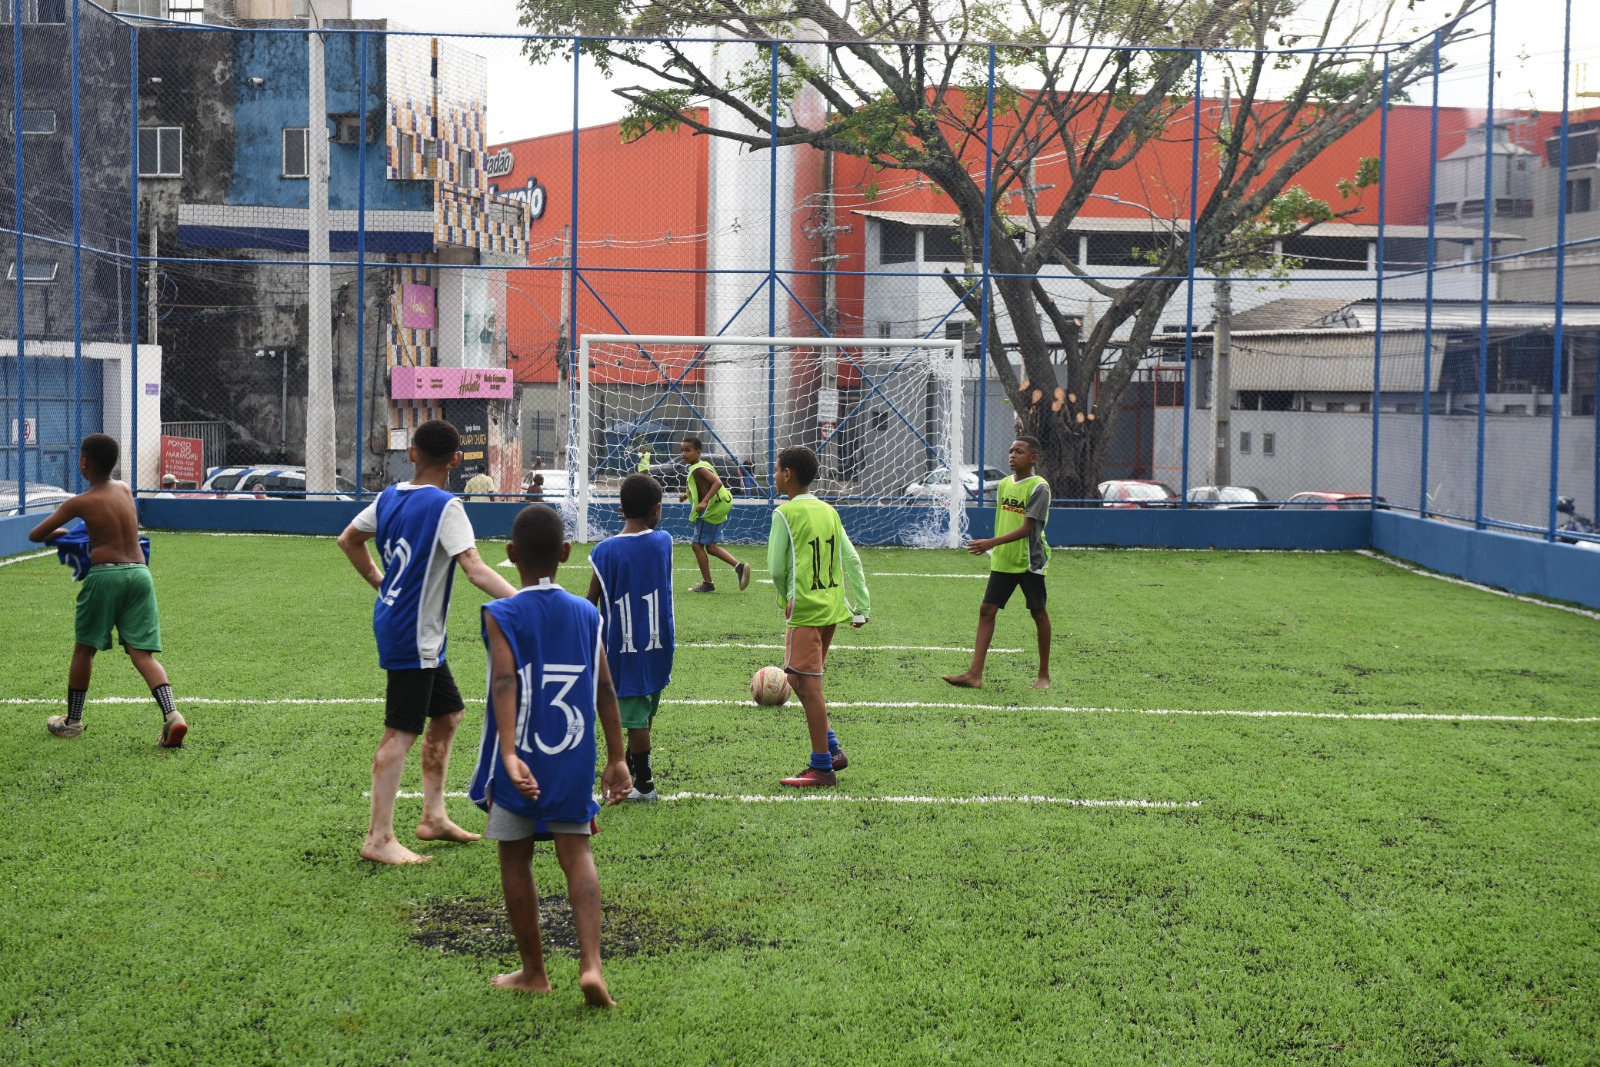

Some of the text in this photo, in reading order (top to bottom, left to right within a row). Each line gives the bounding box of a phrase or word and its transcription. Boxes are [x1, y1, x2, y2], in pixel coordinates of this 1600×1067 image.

[487, 149, 512, 175] adão
[168, 440, 191, 448] PONTO
[808, 534, 839, 590] 11
[615, 588, 662, 653] 11
[516, 661, 587, 755] 13
